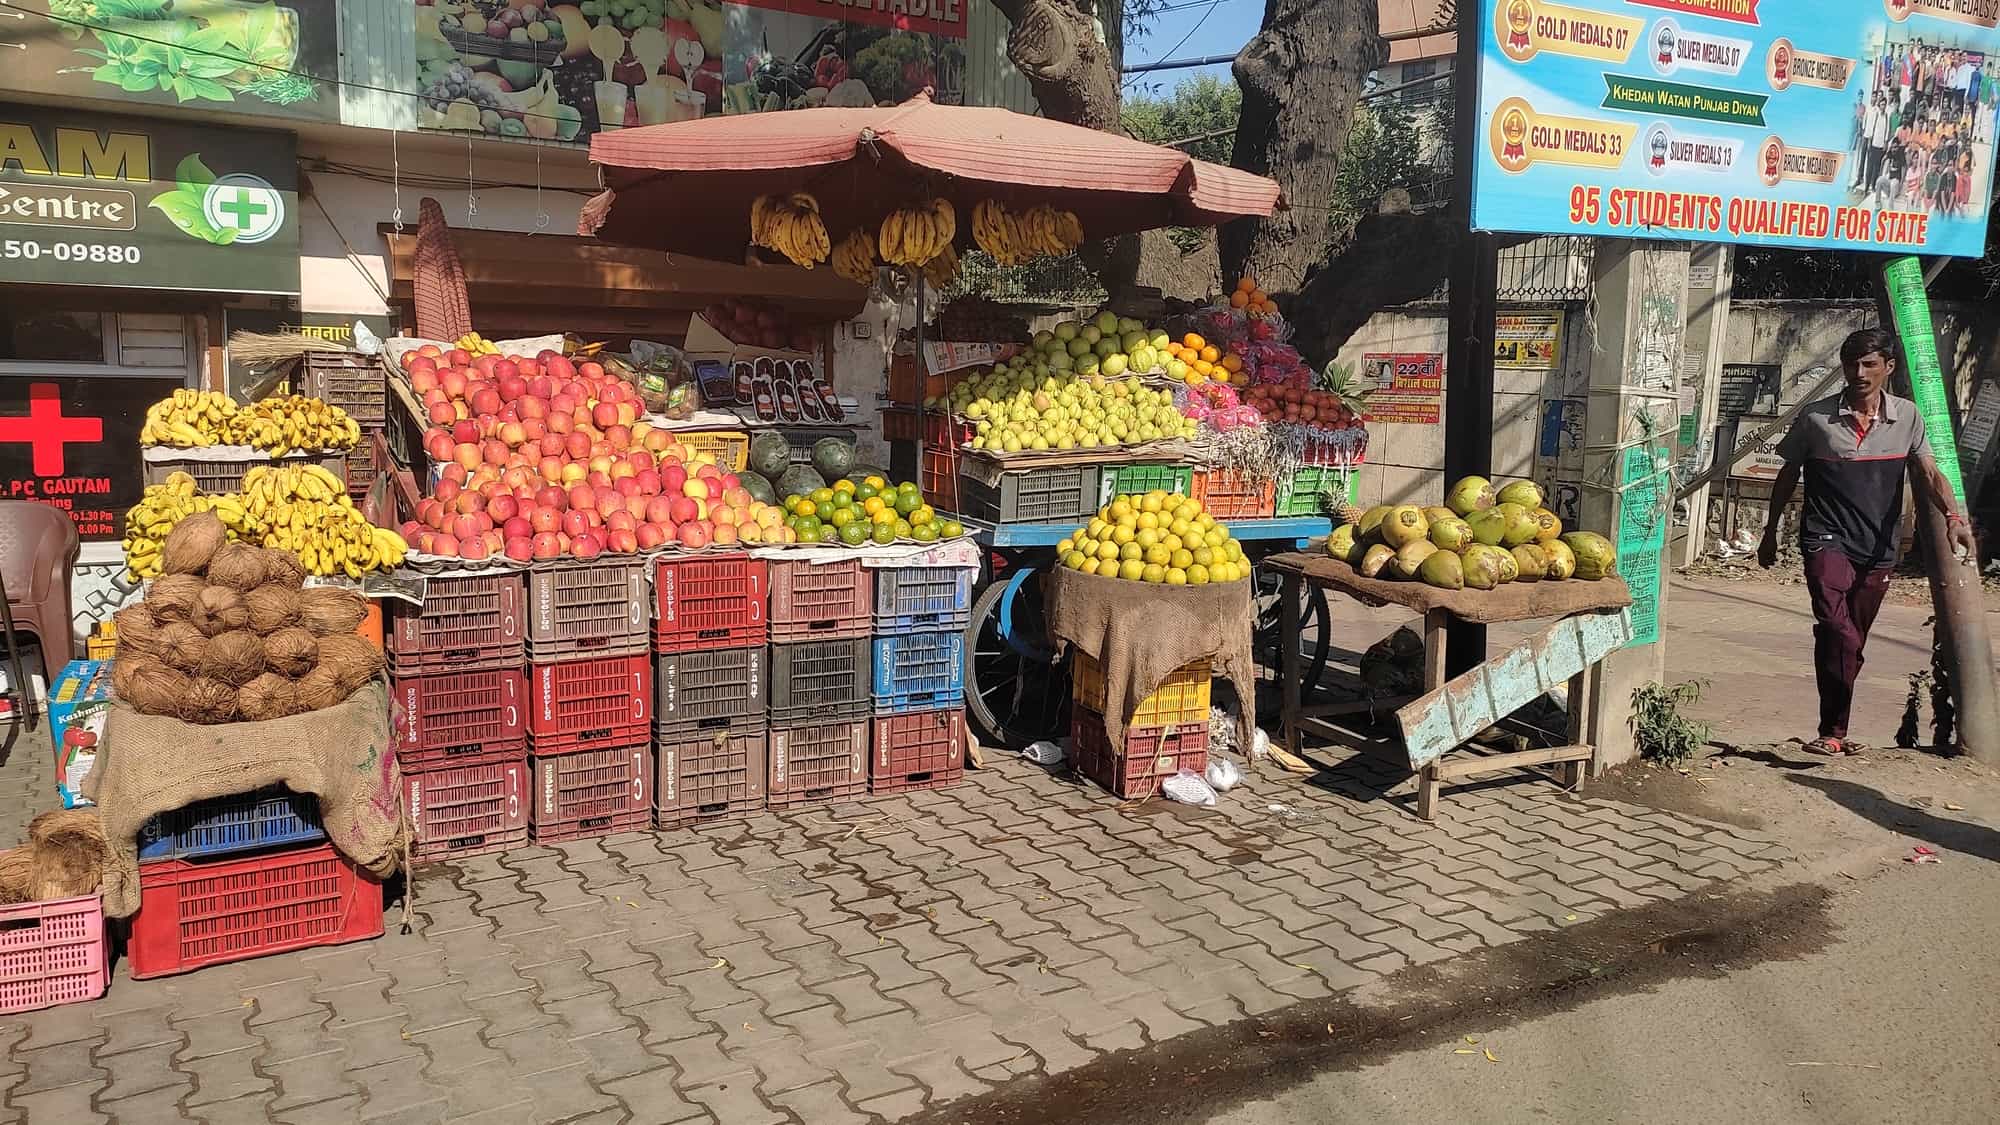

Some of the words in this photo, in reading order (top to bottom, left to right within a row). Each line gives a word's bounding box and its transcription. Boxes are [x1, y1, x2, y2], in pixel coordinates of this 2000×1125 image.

[1537, 15, 1567, 40] GOLD
[1570, 20, 1613, 48] MEDALS
[1615, 29, 1628, 50] 07
[1677, 38, 1700, 60] SILVER
[1702, 42, 1730, 66] MEDALS
[1792, 57, 1816, 78] BRONZE
[1613, 84, 1654, 104] KHEDAN
[1657, 90, 1691, 109] WATAN
[1693, 95, 1729, 113] PUNJAB
[1732, 101, 1759, 117] DIYAN
[0, 122, 151, 182] AM
[1531, 125, 1561, 149] GOLD
[1564, 130, 1607, 154] MEDALS
[1609, 134, 1622, 156] 33
[1669, 140, 1693, 161] SILVER
[1694, 144, 1722, 165] MEDALS
[1723, 146, 1732, 167] 13
[1783, 153, 1806, 173] BRONZE
[1570, 185, 1601, 224] 95
[1607, 187, 1722, 232] STUDENTS
[1728, 197, 1830, 238] QUALIFIED
[1834, 206, 1871, 241] FOR
[1875, 210, 1929, 245] STATE
[0, 239, 141, 264] 50-09880
[1722, 367, 1757, 377] MINDER
[11, 480, 35, 497] PC
[43, 477, 111, 495] GAUTAM
[57, 702, 106, 724] Kashmir
